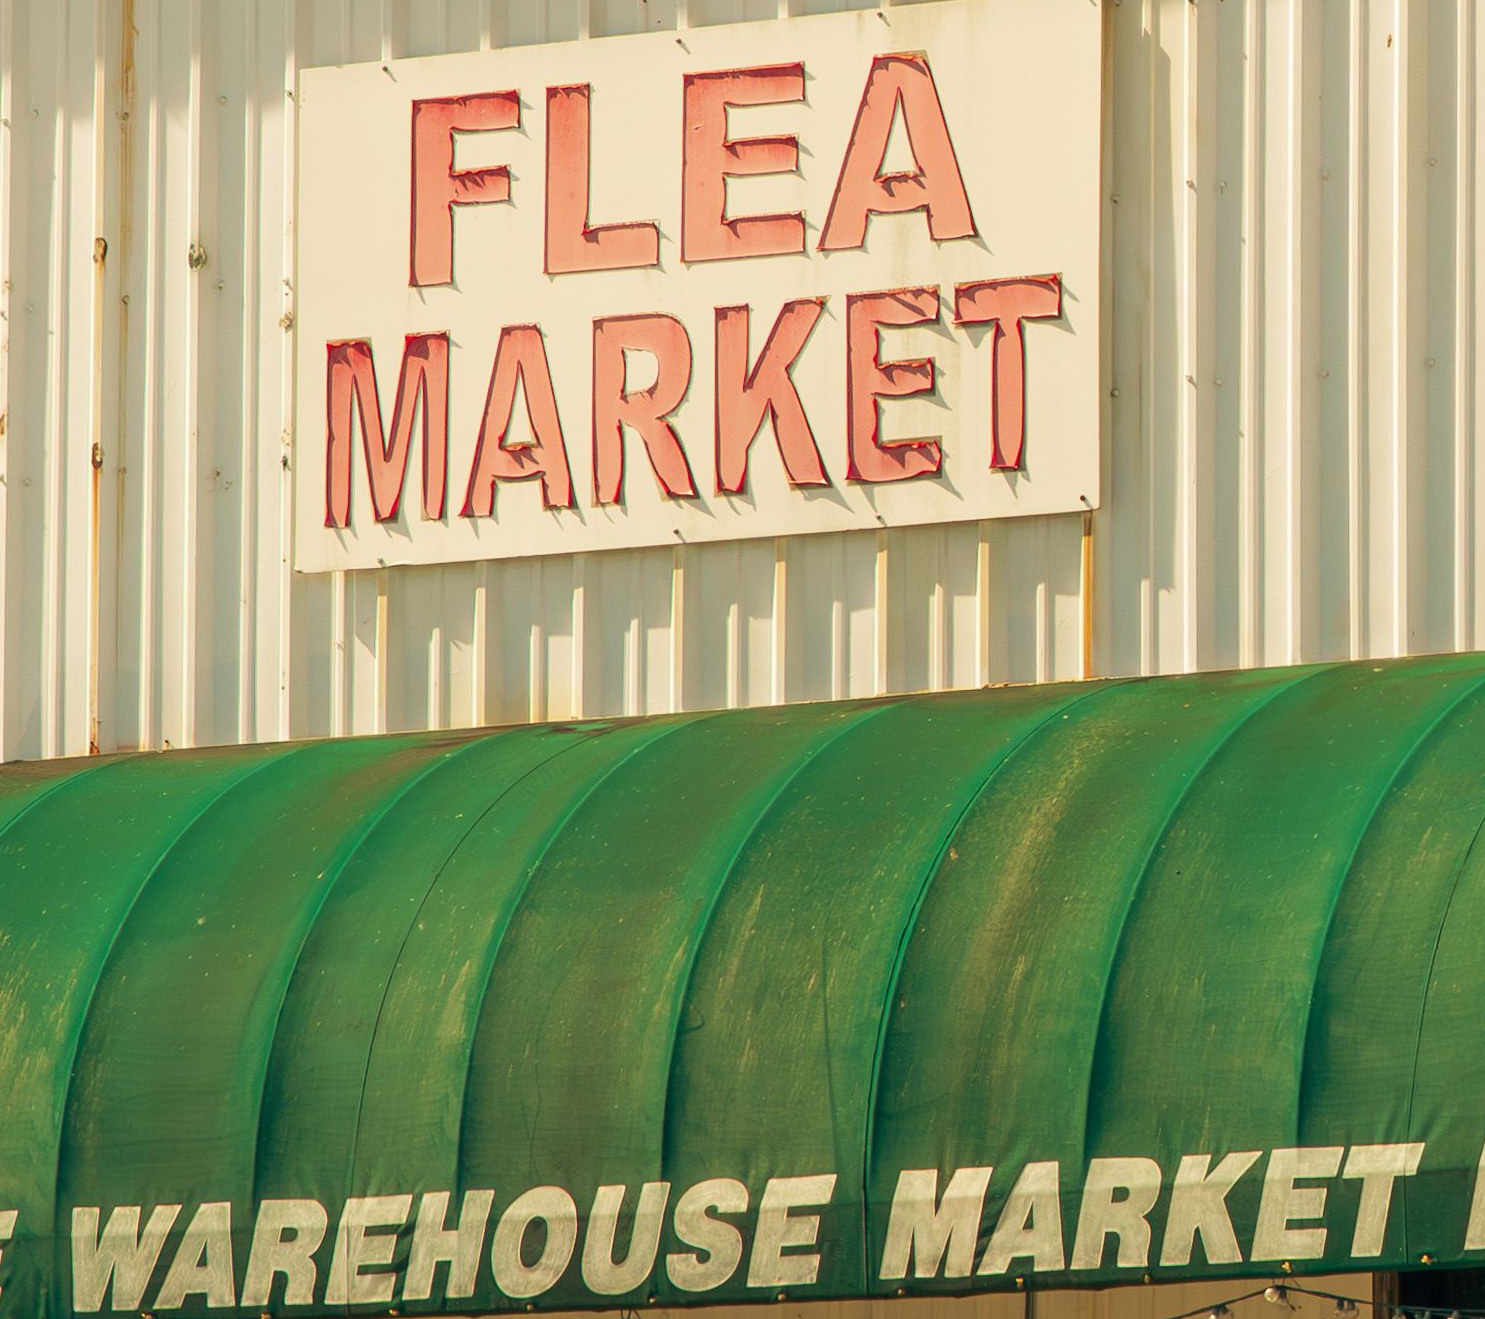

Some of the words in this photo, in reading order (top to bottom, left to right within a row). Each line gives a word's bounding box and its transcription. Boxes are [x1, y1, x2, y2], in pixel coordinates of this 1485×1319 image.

[410, 51, 979, 288] FLEA
[325, 273, 1063, 530] MARKET
[69, 1173, 837, 1315] WAREHOUSE
[879, 1142, 1426, 1280] MARKET
